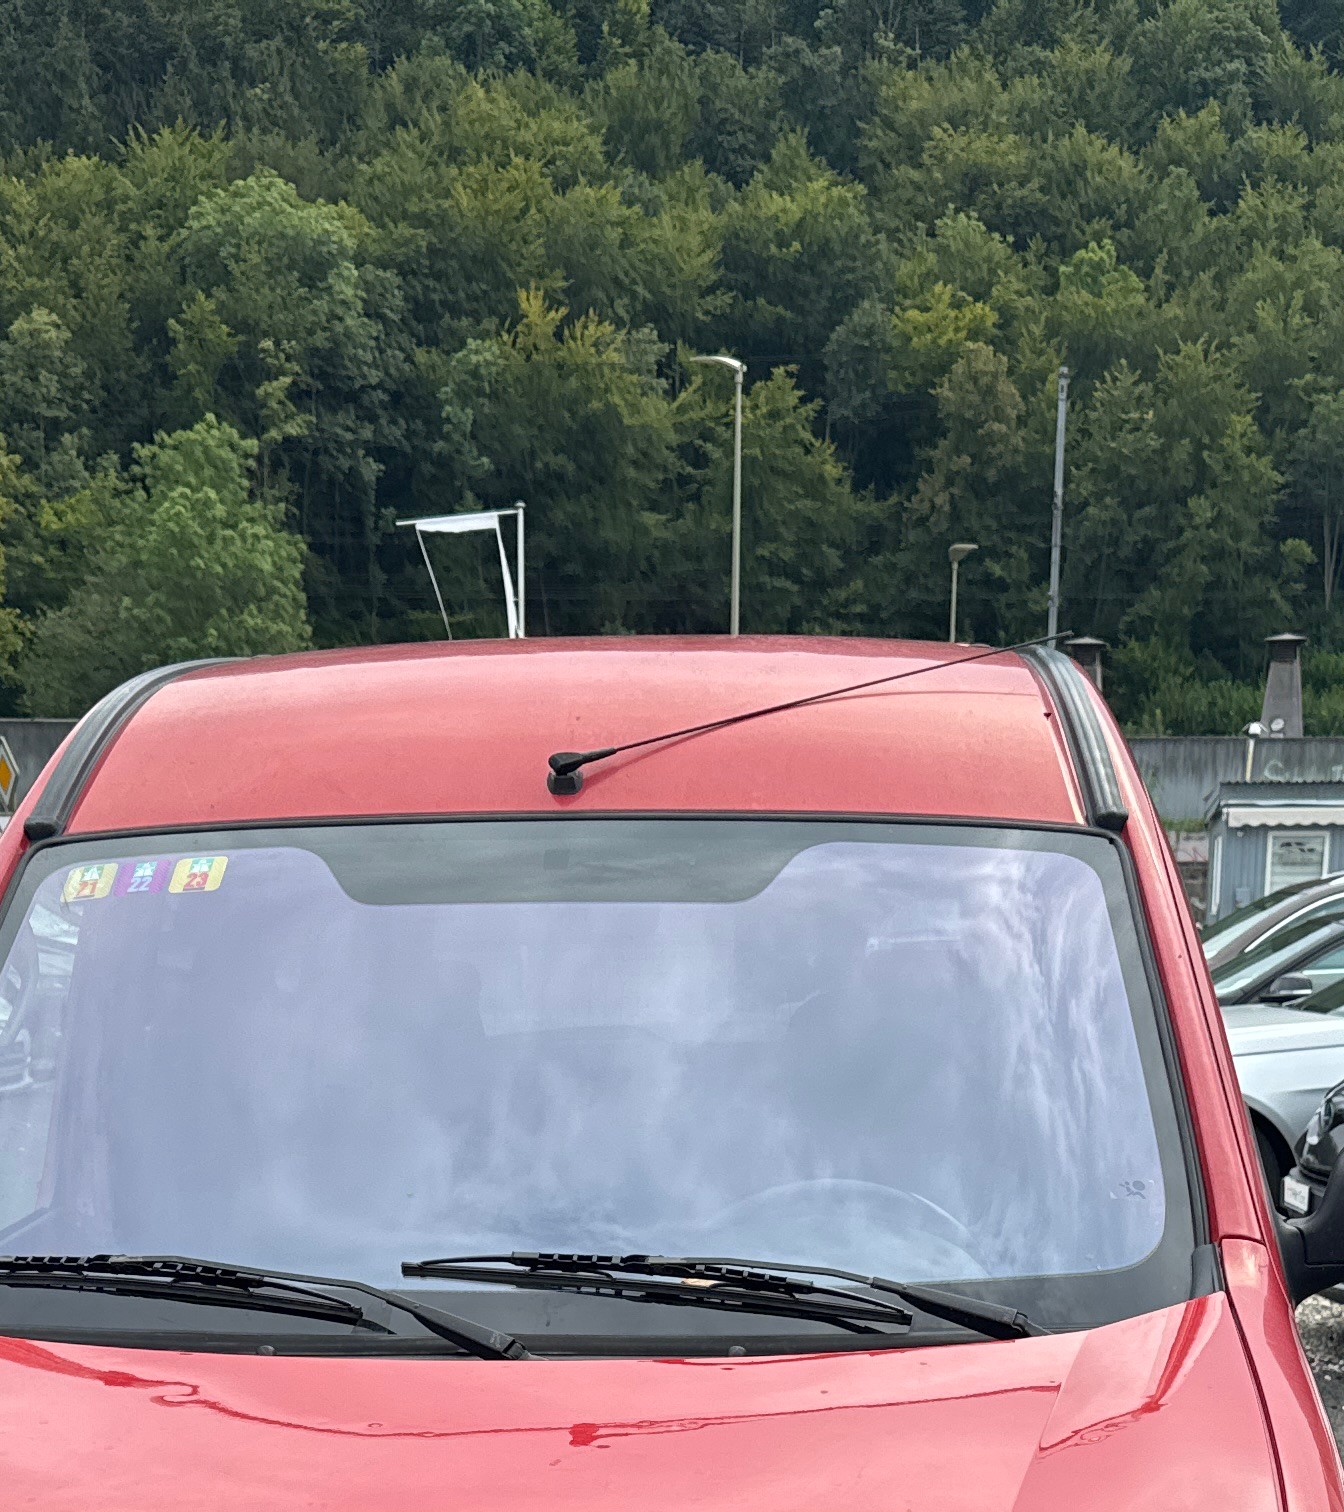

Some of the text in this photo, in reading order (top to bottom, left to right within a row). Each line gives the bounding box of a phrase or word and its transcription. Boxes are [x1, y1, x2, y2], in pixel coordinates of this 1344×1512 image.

[75, 880, 98, 897] 21
[127, 877, 152, 893] 22
[184, 873, 210, 888] 23
